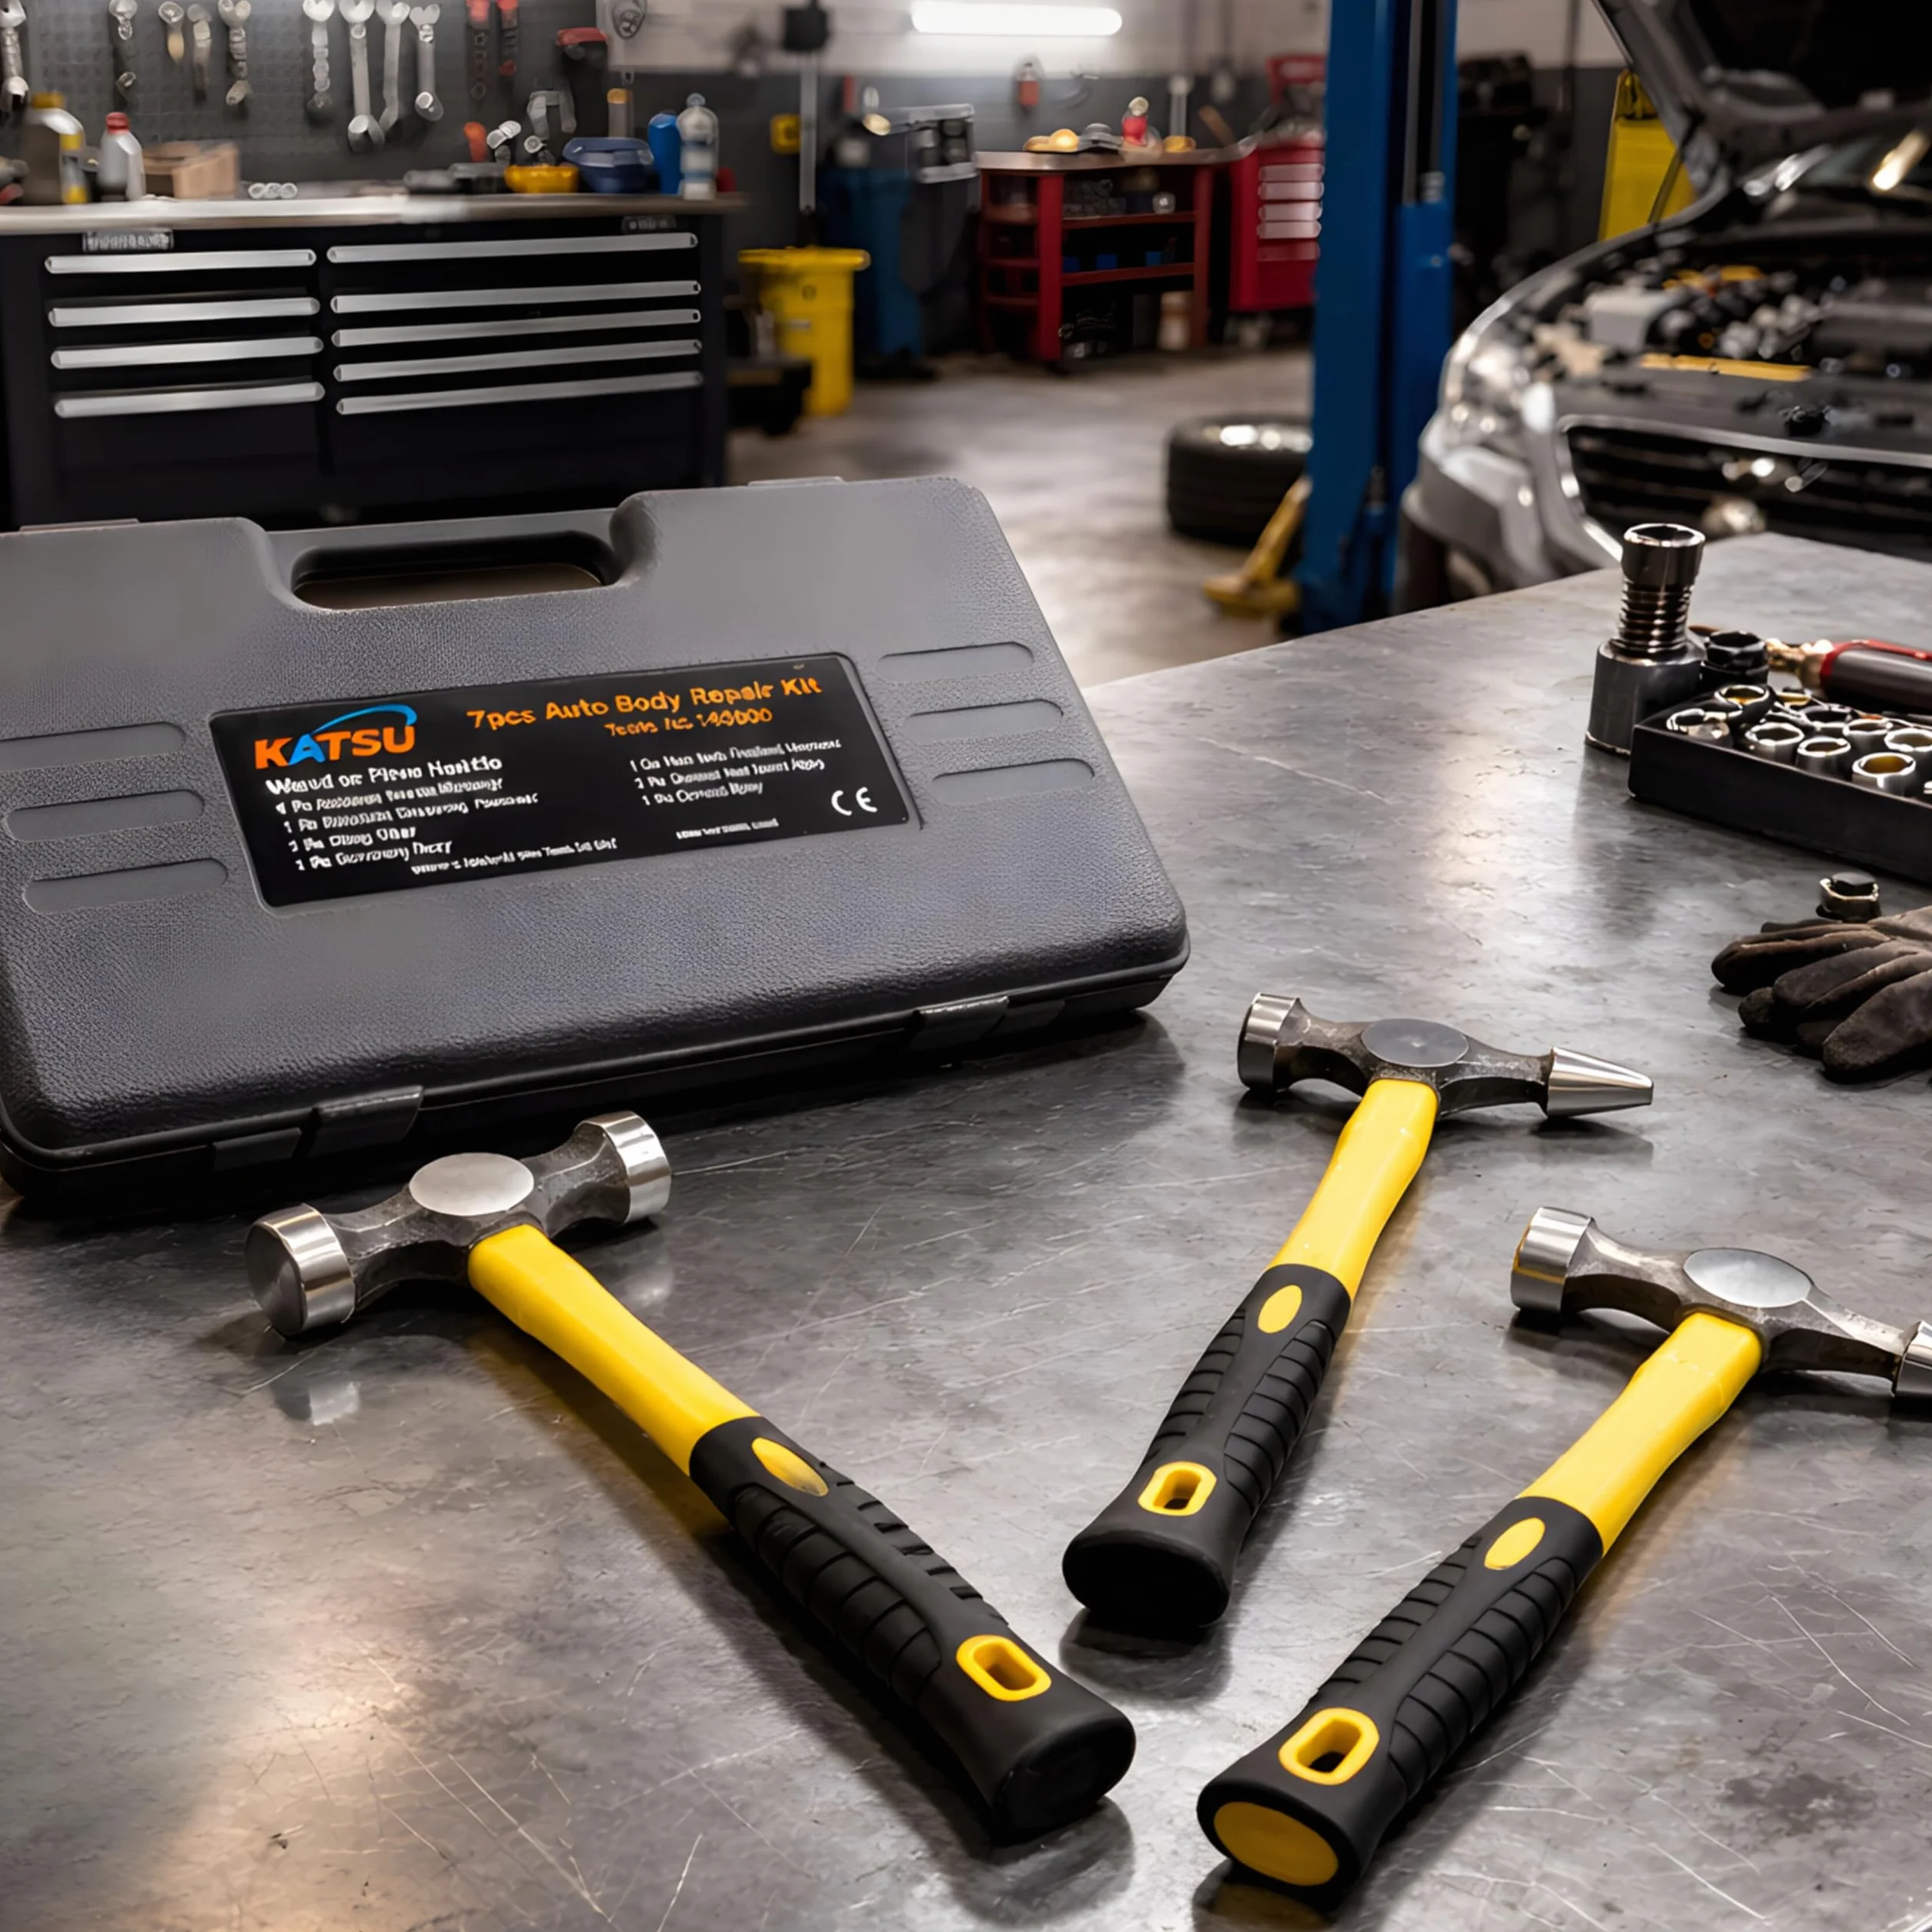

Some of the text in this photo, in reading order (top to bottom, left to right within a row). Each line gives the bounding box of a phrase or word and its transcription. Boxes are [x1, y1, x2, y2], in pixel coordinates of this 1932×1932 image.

[466, 710, 536, 730] 7pcs
[546, 699, 609, 720] Auto
[615, 690, 680, 713] Body
[255, 725, 416, 769] KATSU
[831, 787, 877, 816] CE
